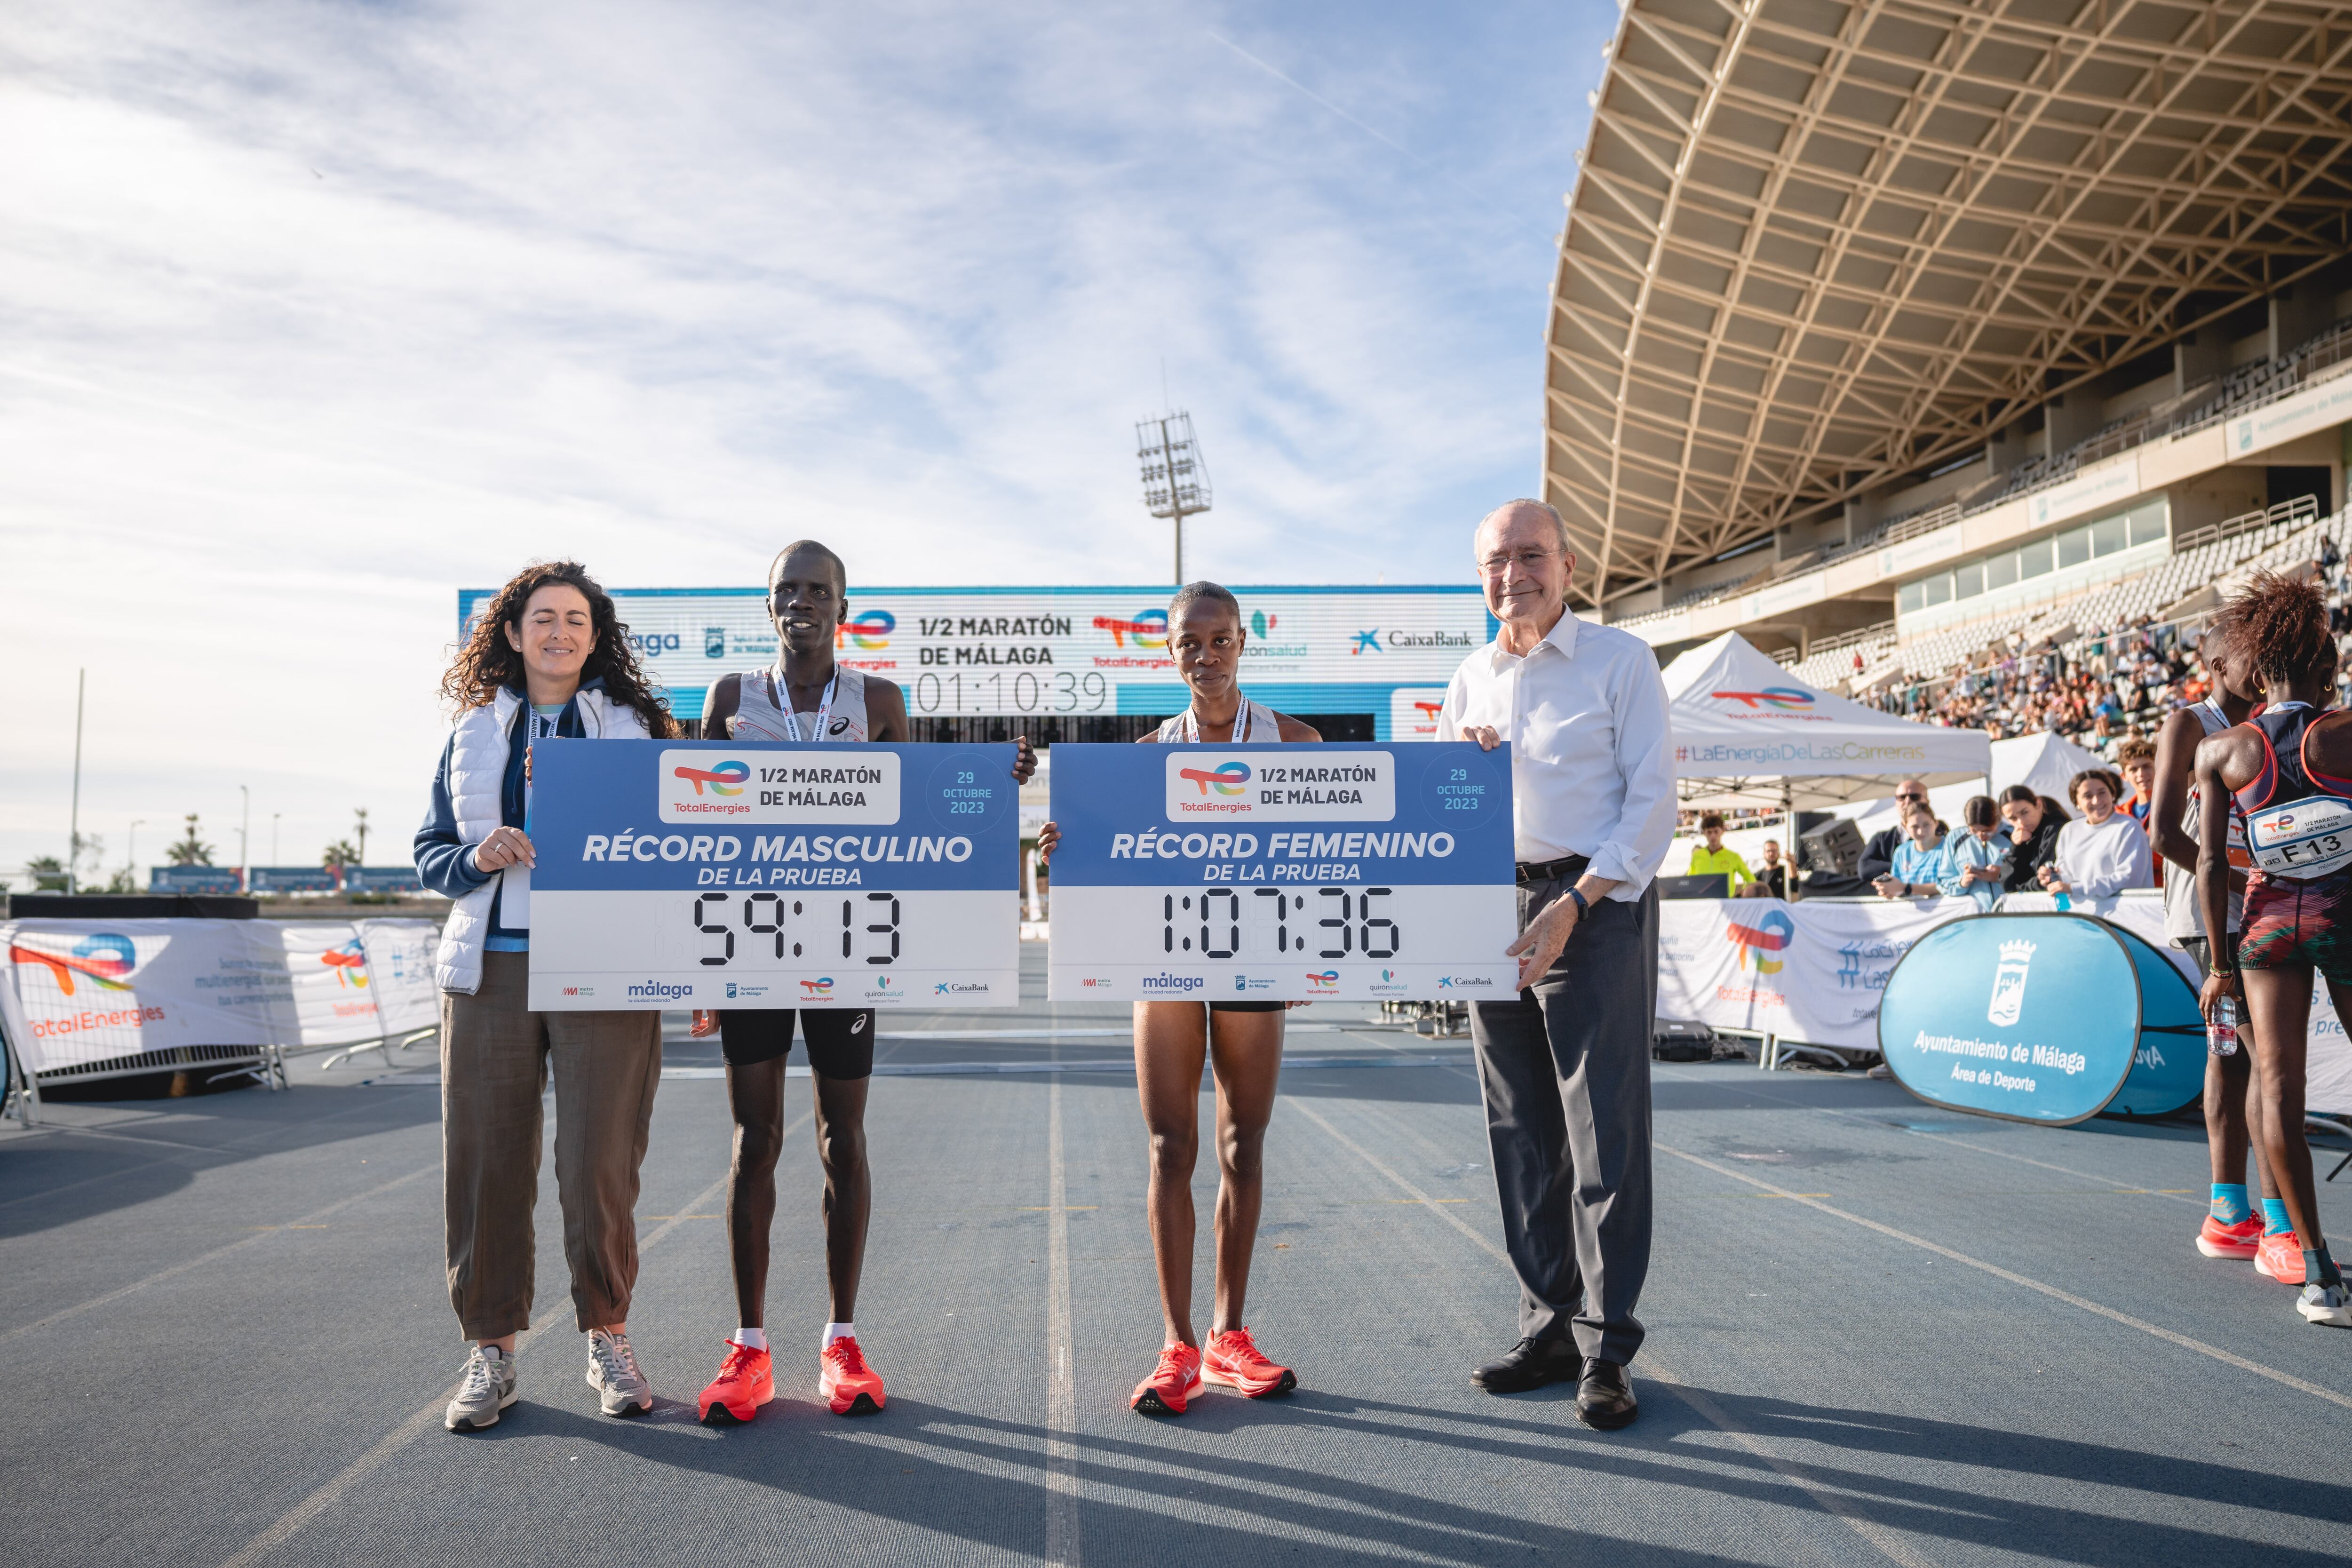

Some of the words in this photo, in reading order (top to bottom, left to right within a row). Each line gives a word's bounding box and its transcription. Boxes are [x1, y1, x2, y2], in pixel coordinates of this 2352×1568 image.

[920, 618, 953, 636] 1/2
[960, 613, 1071, 636] MARATÓN
[1389, 630, 1472, 647] CaixaBank
[921, 648, 951, 665] DE
[956, 643, 1053, 665] MÁLAGA
[917, 672, 1106, 712] 01:10:39
[1724, 713, 1834, 721] TotalEnergies
[760, 768, 787, 783] 1/2
[792, 765, 881, 783] MARATÓN
[957, 772, 974, 784] 29
[1260, 768, 1287, 782] 1/2
[1291, 764, 1376, 782] MARATÓN
[1450, 769, 1467, 781] 29
[760, 791, 784, 805] DE
[788, 788, 866, 806] MÁLAGA
[943, 788, 992, 798] OCTUBRE
[1261, 790, 1283, 804] DE
[1287, 787, 1363, 804] MÁLAGA
[1437, 785, 1485, 795] OCTUBRE
[674, 803, 750, 814] TotalEnergies
[950, 802, 985, 814] 2023
[1180, 803, 1252, 813] TotalEnergies
[1445, 798, 1478, 810] 2023
[2314, 814, 2342, 825] MARATÓN
[2316, 821, 2340, 831] MÁLAGA
[1110, 826, 1259, 859] RÉCORD
[1267, 832, 1455, 858] FEMENINO
[2265, 830, 2300, 842] TotalEnergies
[582, 828, 742, 862] RÉCORD
[751, 836, 973, 863] MASCULINO
[697, 868, 730, 885] DE
[735, 868, 763, 885] LA
[770, 868, 862, 885] PRUEBA
[1204, 864, 1234, 881] DE
[1239, 864, 1266, 881] LA
[1272, 864, 1361, 880] PRUEBA
[1164, 888, 1399, 959] 1:07:36
[1717, 985, 1785, 1008] TotalEnergies
[1914, 1030, 2008, 1060] Ayuntamiento
[2010, 1042, 2029, 1064] de
[2032, 1044, 2086, 1075] Málaga
[1950, 1061, 1977, 1082] Área
[1977, 1069, 1992, 1085] de
[1993, 1071, 2036, 1092] Deporte
